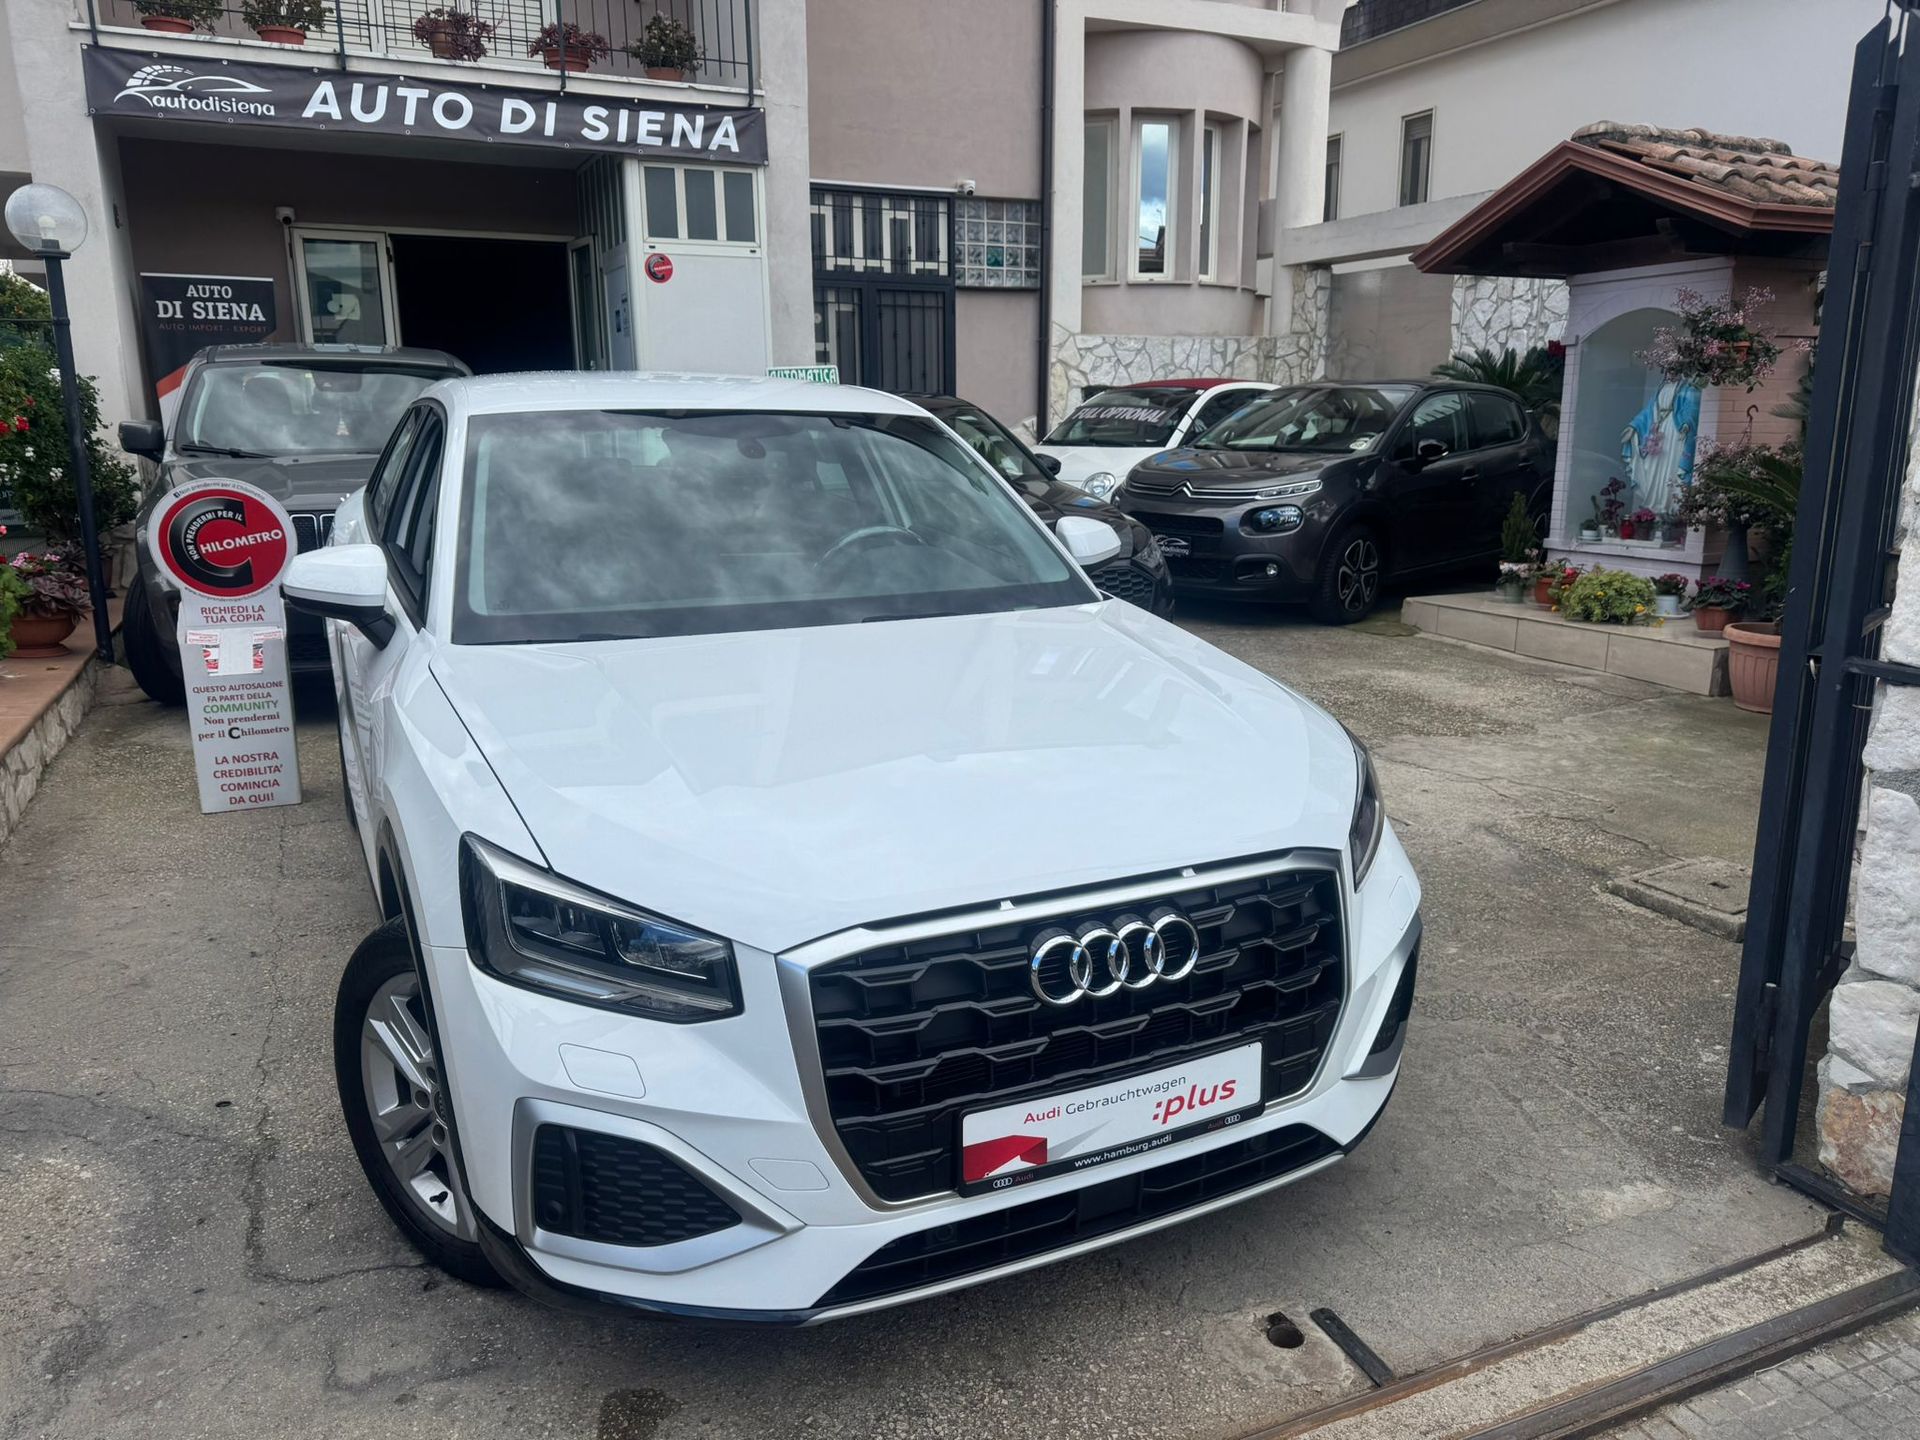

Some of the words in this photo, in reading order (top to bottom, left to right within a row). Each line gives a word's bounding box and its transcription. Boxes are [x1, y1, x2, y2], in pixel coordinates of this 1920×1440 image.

[152, 93, 275, 117] autodisiena
[301, 80, 473, 130] AUTO
[500, 98, 557, 137] DI
[581, 105, 740, 153] SIENA
[186, 284, 232, 299] AUTO
[156, 300, 184, 319] DI
[192, 301, 266, 321] SIENA
[159, 323, 185, 331] AUTO
[189, 324, 223, 332] IMPORT
[233, 325, 267, 333] EXPORT
[1072, 407, 1102, 420] FULL
[1100, 406, 1166, 423] OPTIONAL
[217, 510, 234, 518] PER
[235, 513, 243, 521] IL
[186, 512, 216, 543] PRENDERMI
[186, 545, 200, 560] NON
[200, 606, 249, 615] RICHIEDI
[252, 605, 265, 613] LA
[203, 615, 227, 624] TUA
[230, 614, 264, 623] COPIA
[192, 685, 227, 694] QUESTO
[228, 681, 284, 691] AUTOSALONE
[207, 695, 218, 703] FA
[219, 694, 245, 702] PARTE
[247, 692, 272, 700] DELLA
[203, 700, 279, 714] COMMUNITY
[203, 716, 225, 725] Non
[227, 711, 280, 726] prendermi
[198, 732, 215, 742] per
[218, 729, 225, 738] il
[228, 726, 290, 739] Chilometro
[215, 756, 229, 765] LA
[232, 751, 279, 764] NOSTRA
[220, 779, 280, 792] COMINCIA
[229, 796, 246, 805] DA
[248, 792, 275, 804] QUI!
[1023, 1106, 1061, 1124] Audi
[1065, 1076, 1187, 1115] Gebrauchtwagen
[1074, 1133, 1173, 1168] www.hamburg.audi
[1014, 1173, 1034, 1183] Audi
